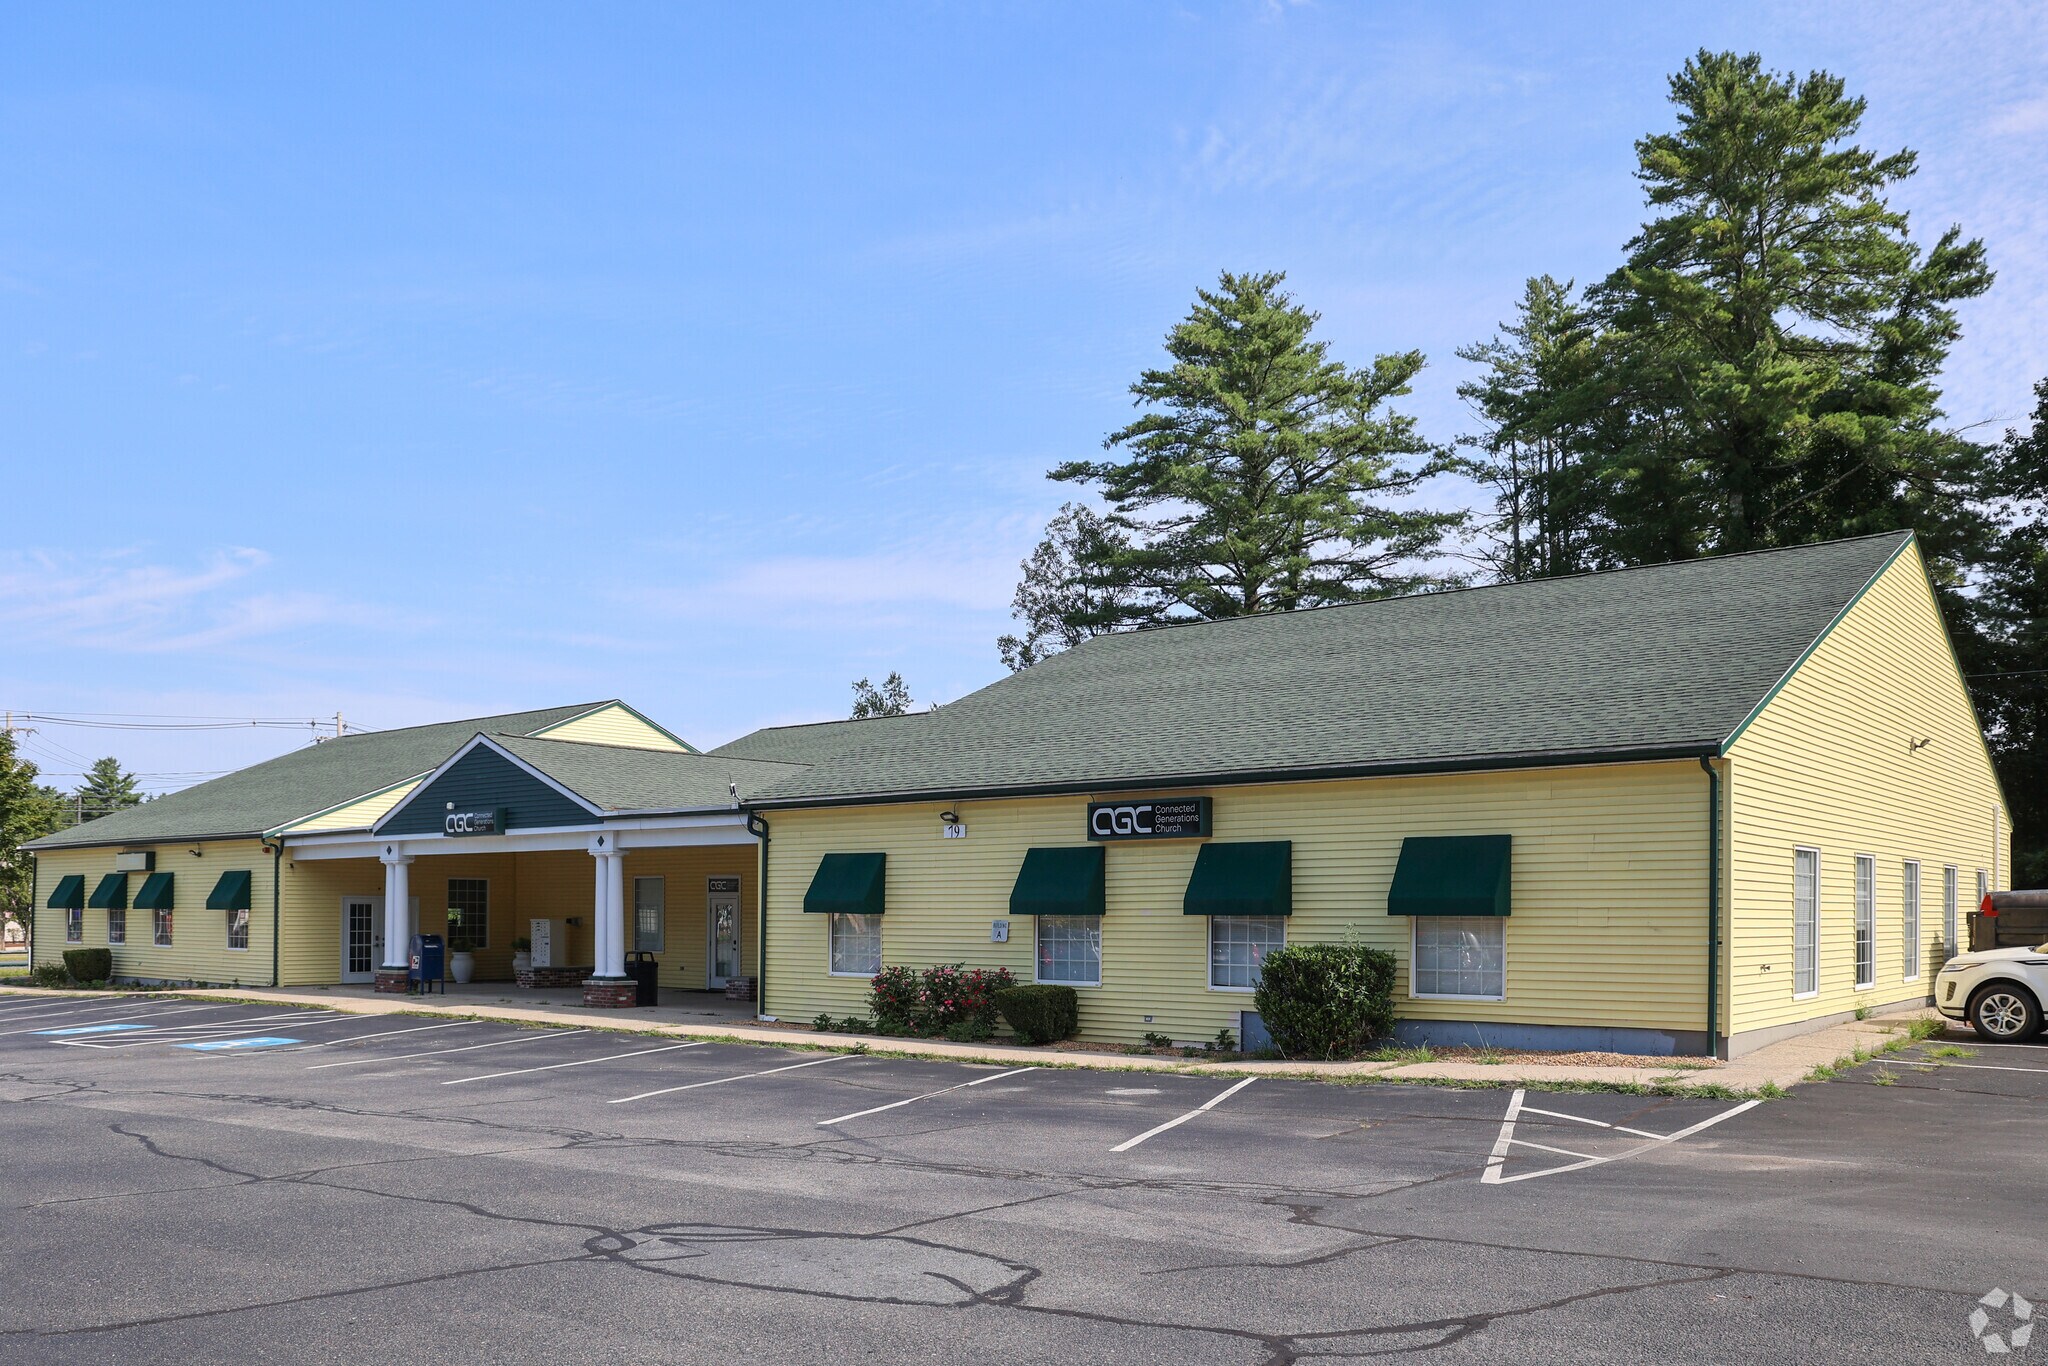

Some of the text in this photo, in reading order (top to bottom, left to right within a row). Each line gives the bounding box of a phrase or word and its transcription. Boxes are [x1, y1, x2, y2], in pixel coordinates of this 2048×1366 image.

[1155, 803, 1196, 814] Connected
[445, 812, 473, 833] CGC
[1092, 805, 1152, 835] CGC
[1155, 812, 1200, 823] Generations
[1155, 823, 1182, 833] Church
[710, 881, 727, 890] CGC
[996, 930, 1002, 939] A
